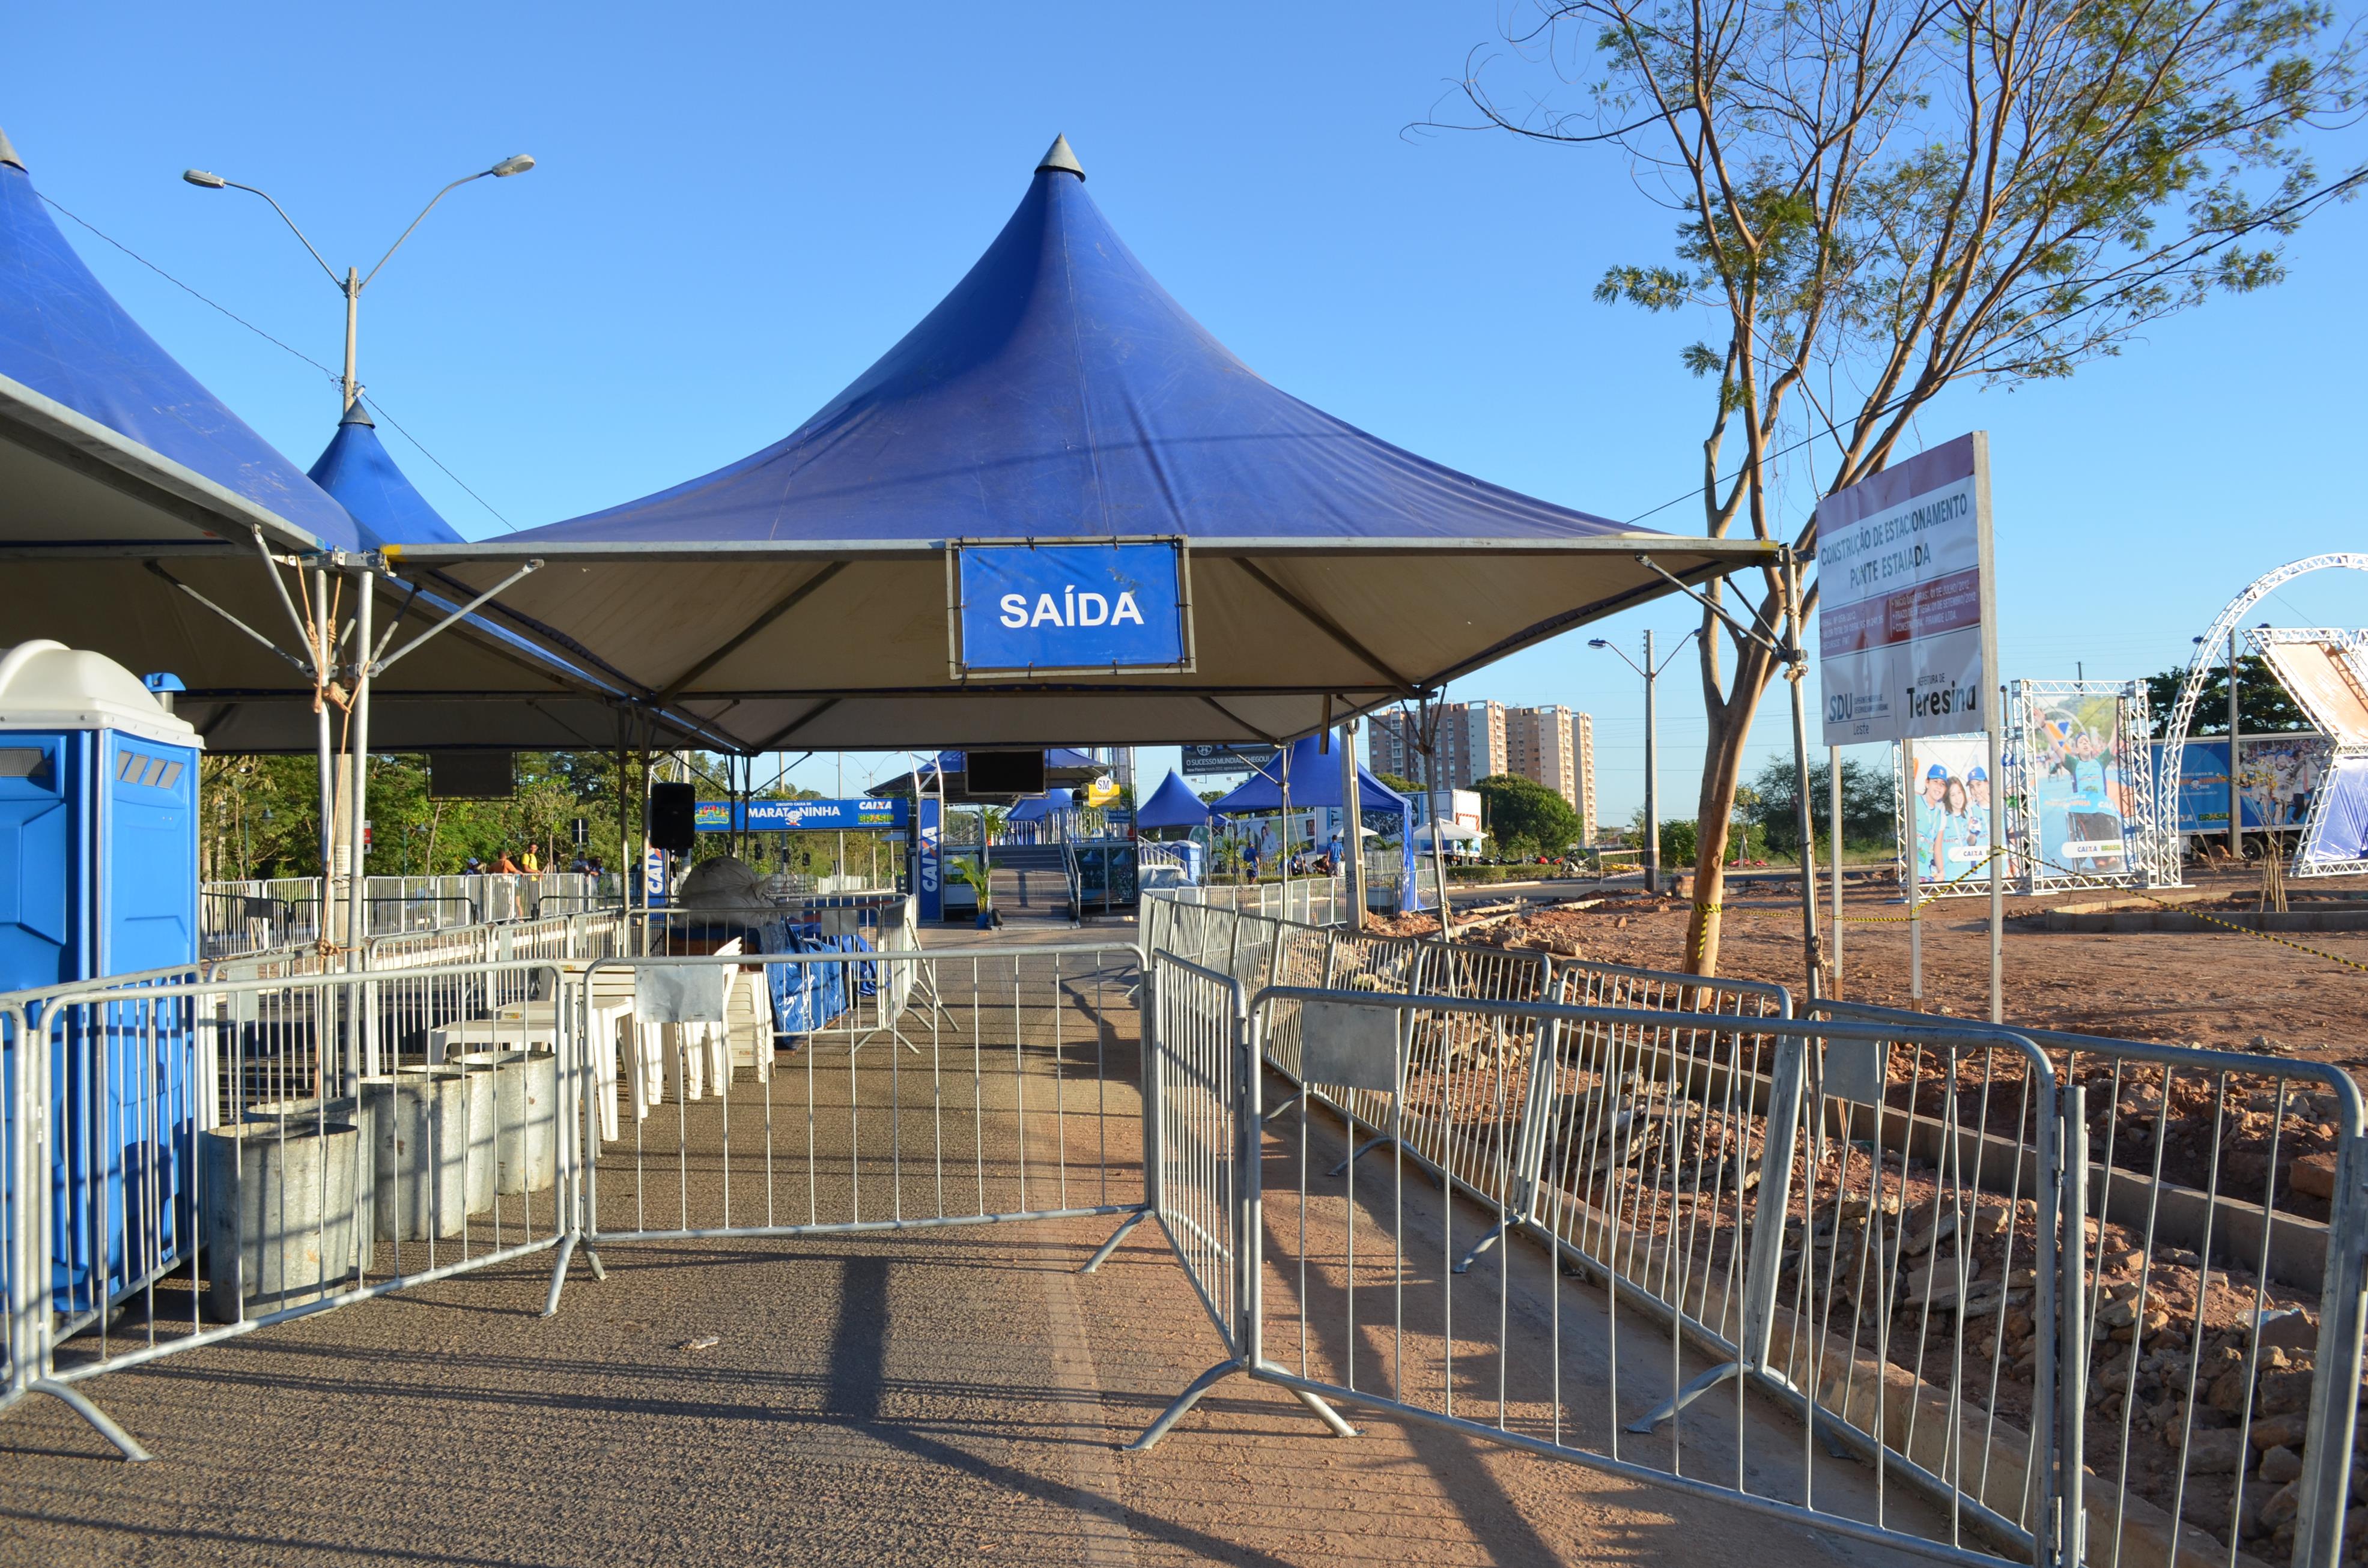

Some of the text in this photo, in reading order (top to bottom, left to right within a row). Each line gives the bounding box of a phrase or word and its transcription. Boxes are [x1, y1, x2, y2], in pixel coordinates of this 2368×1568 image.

[1821, 493, 1967, 566] CONSTRUÇÃO DE ESTACIONAMENTO
[1850, 543, 1931, 589] PONTE ESTAIADA
[1000, 585, 1144, 629] SAÍDA
[1939, 673, 1945, 683] DE
[1829, 692, 1853, 722] SDU
[1907, 680, 1976, 719] Teresina
[1853, 722, 1869, 736] Leste
[1191, 757, 1217, 766] SUCESSO
[1245, 755, 1270, 763] CHEGOU!
[1097, 779, 1110, 790] SM
[857, 814, 894, 823] BRASIL
[858, 801, 893, 810] CAIXA
[648, 842, 663, 894] CAIX
[922, 826, 937, 892] CAIXA
